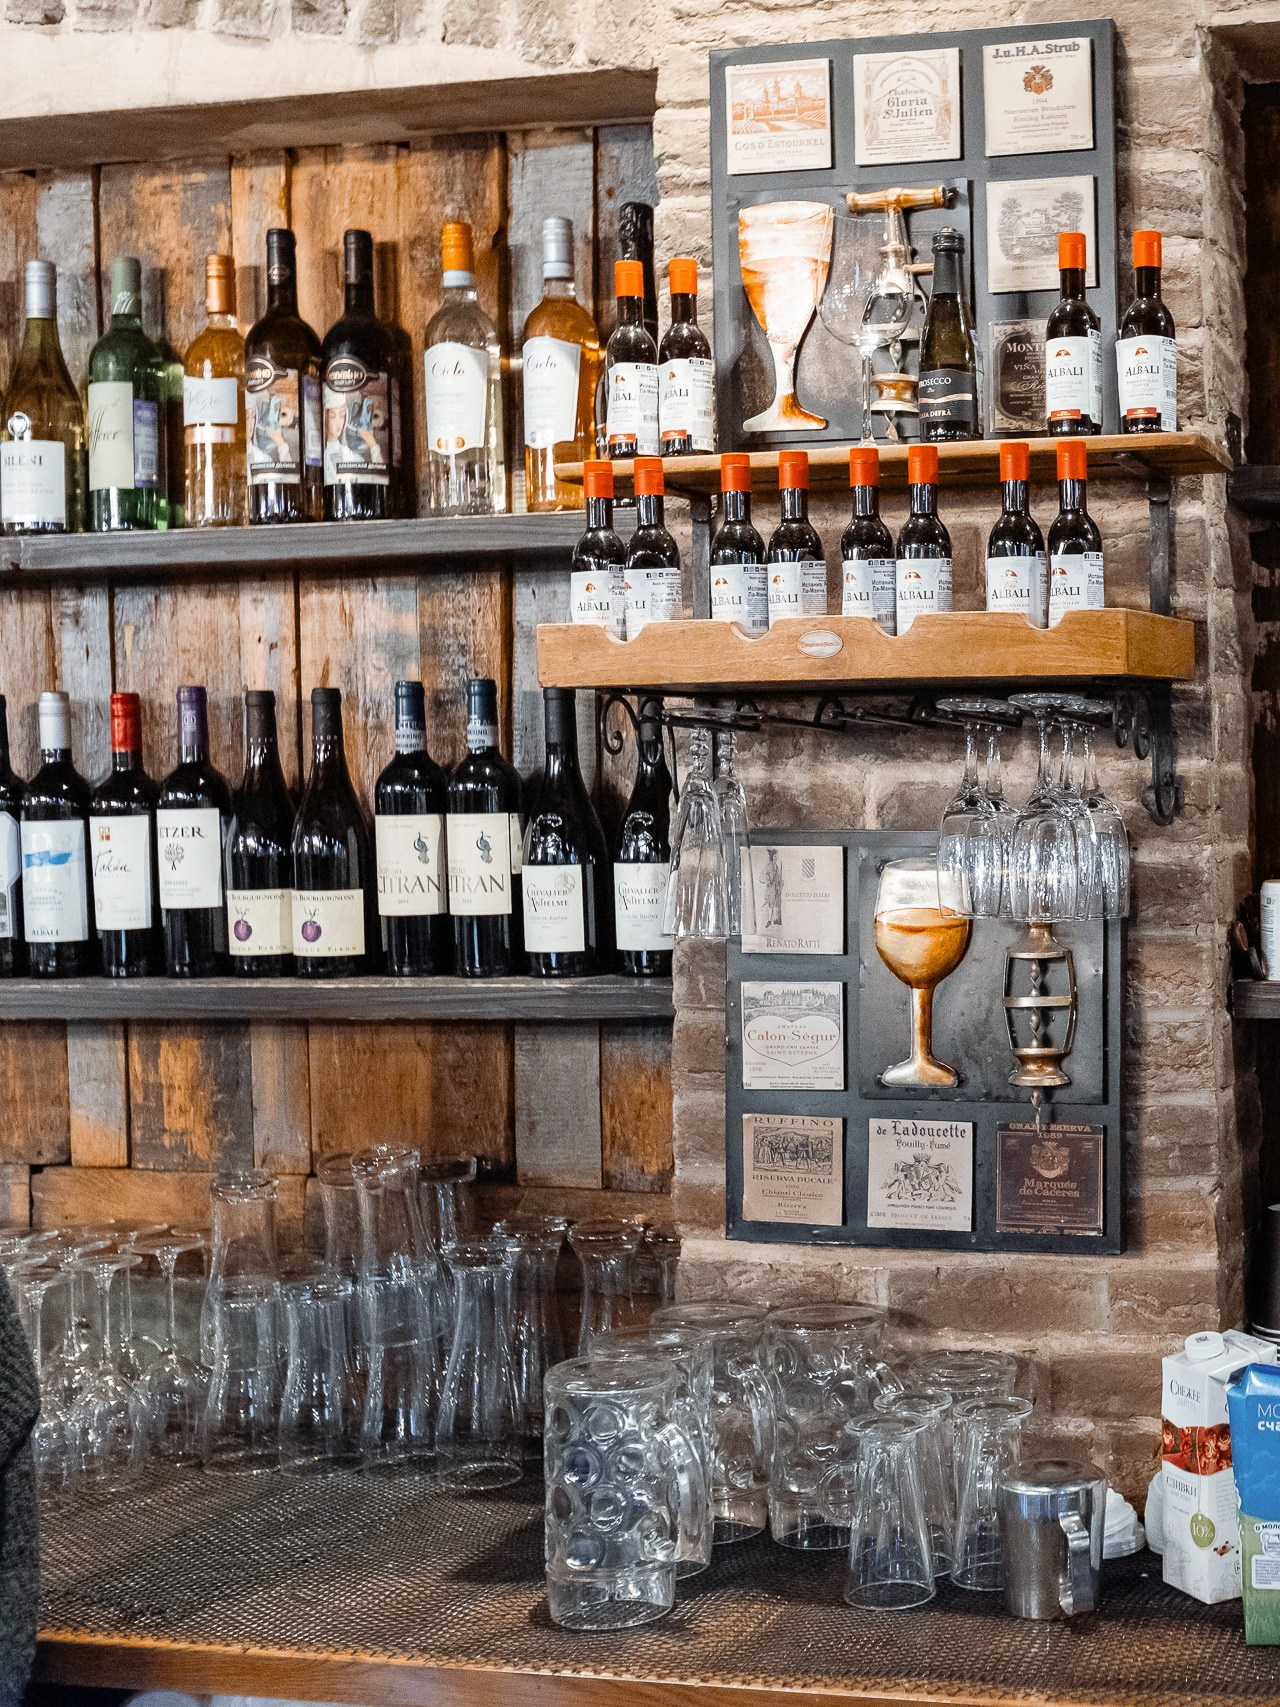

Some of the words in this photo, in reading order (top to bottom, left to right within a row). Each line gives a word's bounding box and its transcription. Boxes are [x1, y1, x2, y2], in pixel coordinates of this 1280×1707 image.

[1006, 342, 1046, 353] MONT
[431, 360, 465, 377] Cielo
[526, 354, 558, 371] Cielo
[1048, 366, 1084, 380] ALBALI
[1125, 365, 1160, 377] ALBALI
[845, 592, 870, 602] LBALI
[898, 590, 935, 601] ALBALI
[991, 588, 1031, 600] ALBALI
[1051, 586, 1081, 597] LBALI
[577, 601, 610, 612] ALBALI
[449, 874, 504, 893] ITRAN
[766, 938, 797, 948] RENATO
[798, 938, 820, 949] RATTI
[754, 1117, 834, 1127] RUFFINO
[876, 1125, 887, 1135] de
[891, 1120, 967, 1138] Ladoucette
[895, 1137, 951, 1151] Pouilly-Fumé
[752, 1174, 796, 1182] RISERVA
[796, 1176, 834, 1184] DUCALE
[1023, 1178, 1077, 1191] Marqués
[1019, 1187, 1033, 1195] de
[1034, 1187, 1080, 1198] Cáceres
[1170, 1379, 1201, 1403] СВЕЖЕЕ
[1166, 1476, 1197, 1497] СЛИВКИ
[1192, 1522, 1214, 1538] 10%
